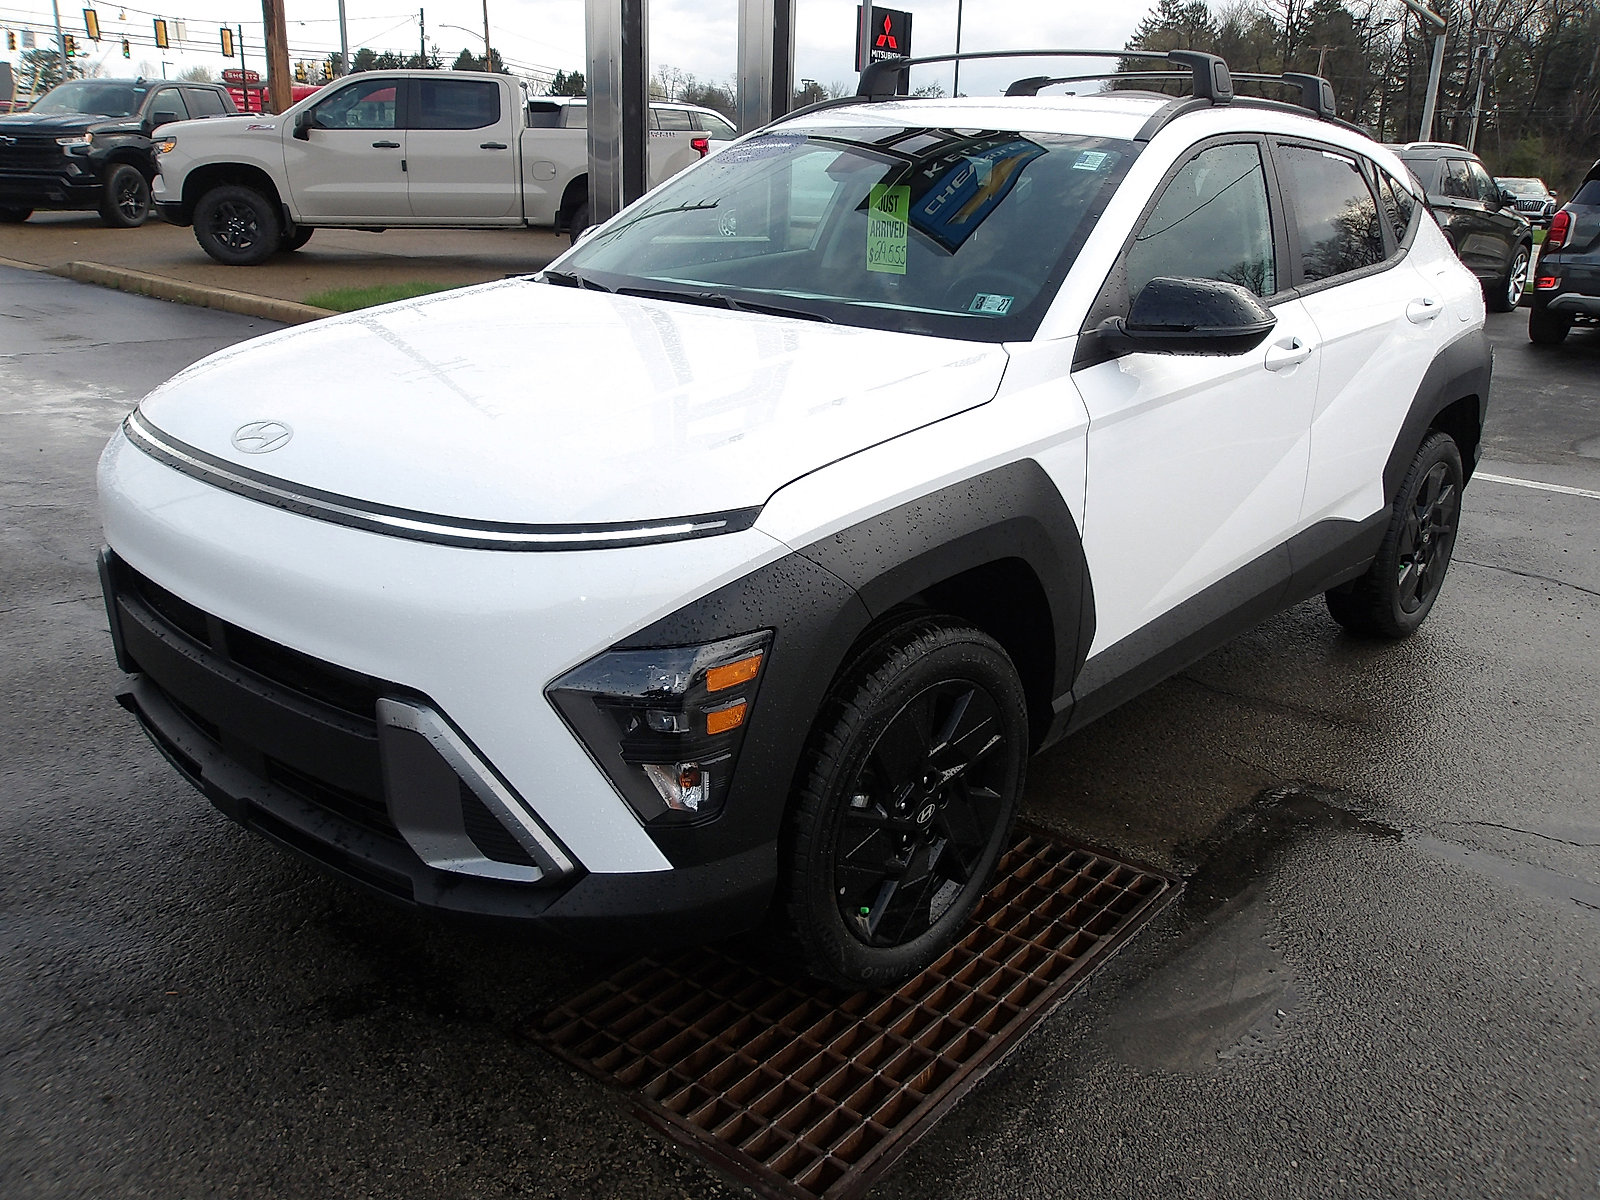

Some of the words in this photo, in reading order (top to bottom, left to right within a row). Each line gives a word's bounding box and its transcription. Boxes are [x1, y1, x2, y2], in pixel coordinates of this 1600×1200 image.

[878, 194, 900, 213] JUST
[869, 220, 905, 239] ARRIVED
[974, 296, 986, 310] 3
[996, 298, 1010, 312] 27
